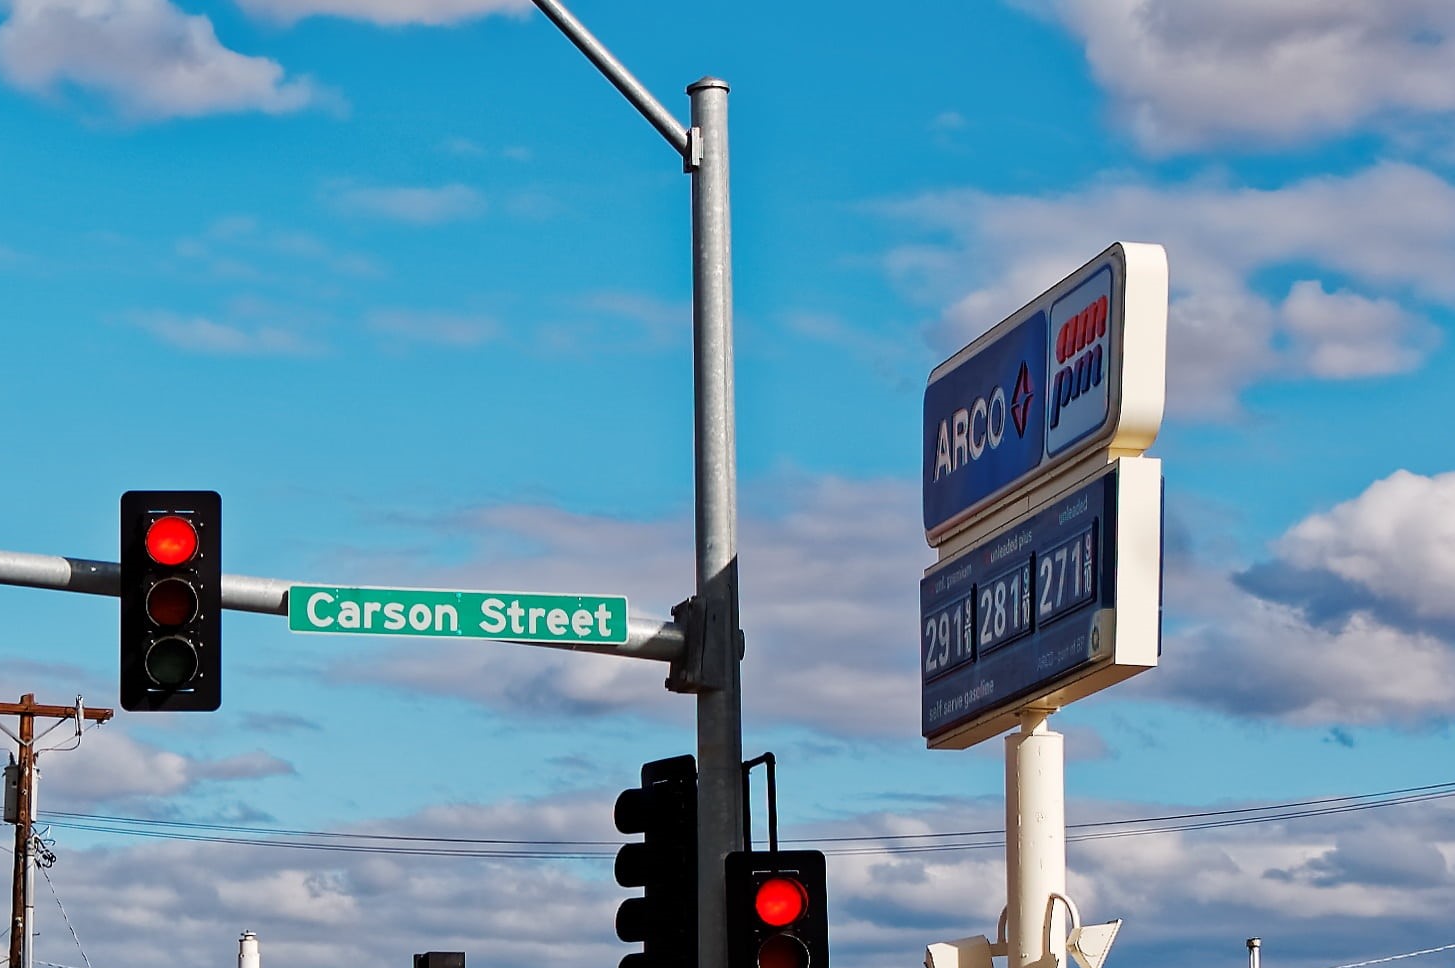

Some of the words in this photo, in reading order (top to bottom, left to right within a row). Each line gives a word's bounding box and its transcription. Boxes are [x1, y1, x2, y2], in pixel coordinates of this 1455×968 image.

[933, 385, 1005, 482] ARCO
[306, 592, 458, 633] Carson
[479, 597, 612, 638] Street
